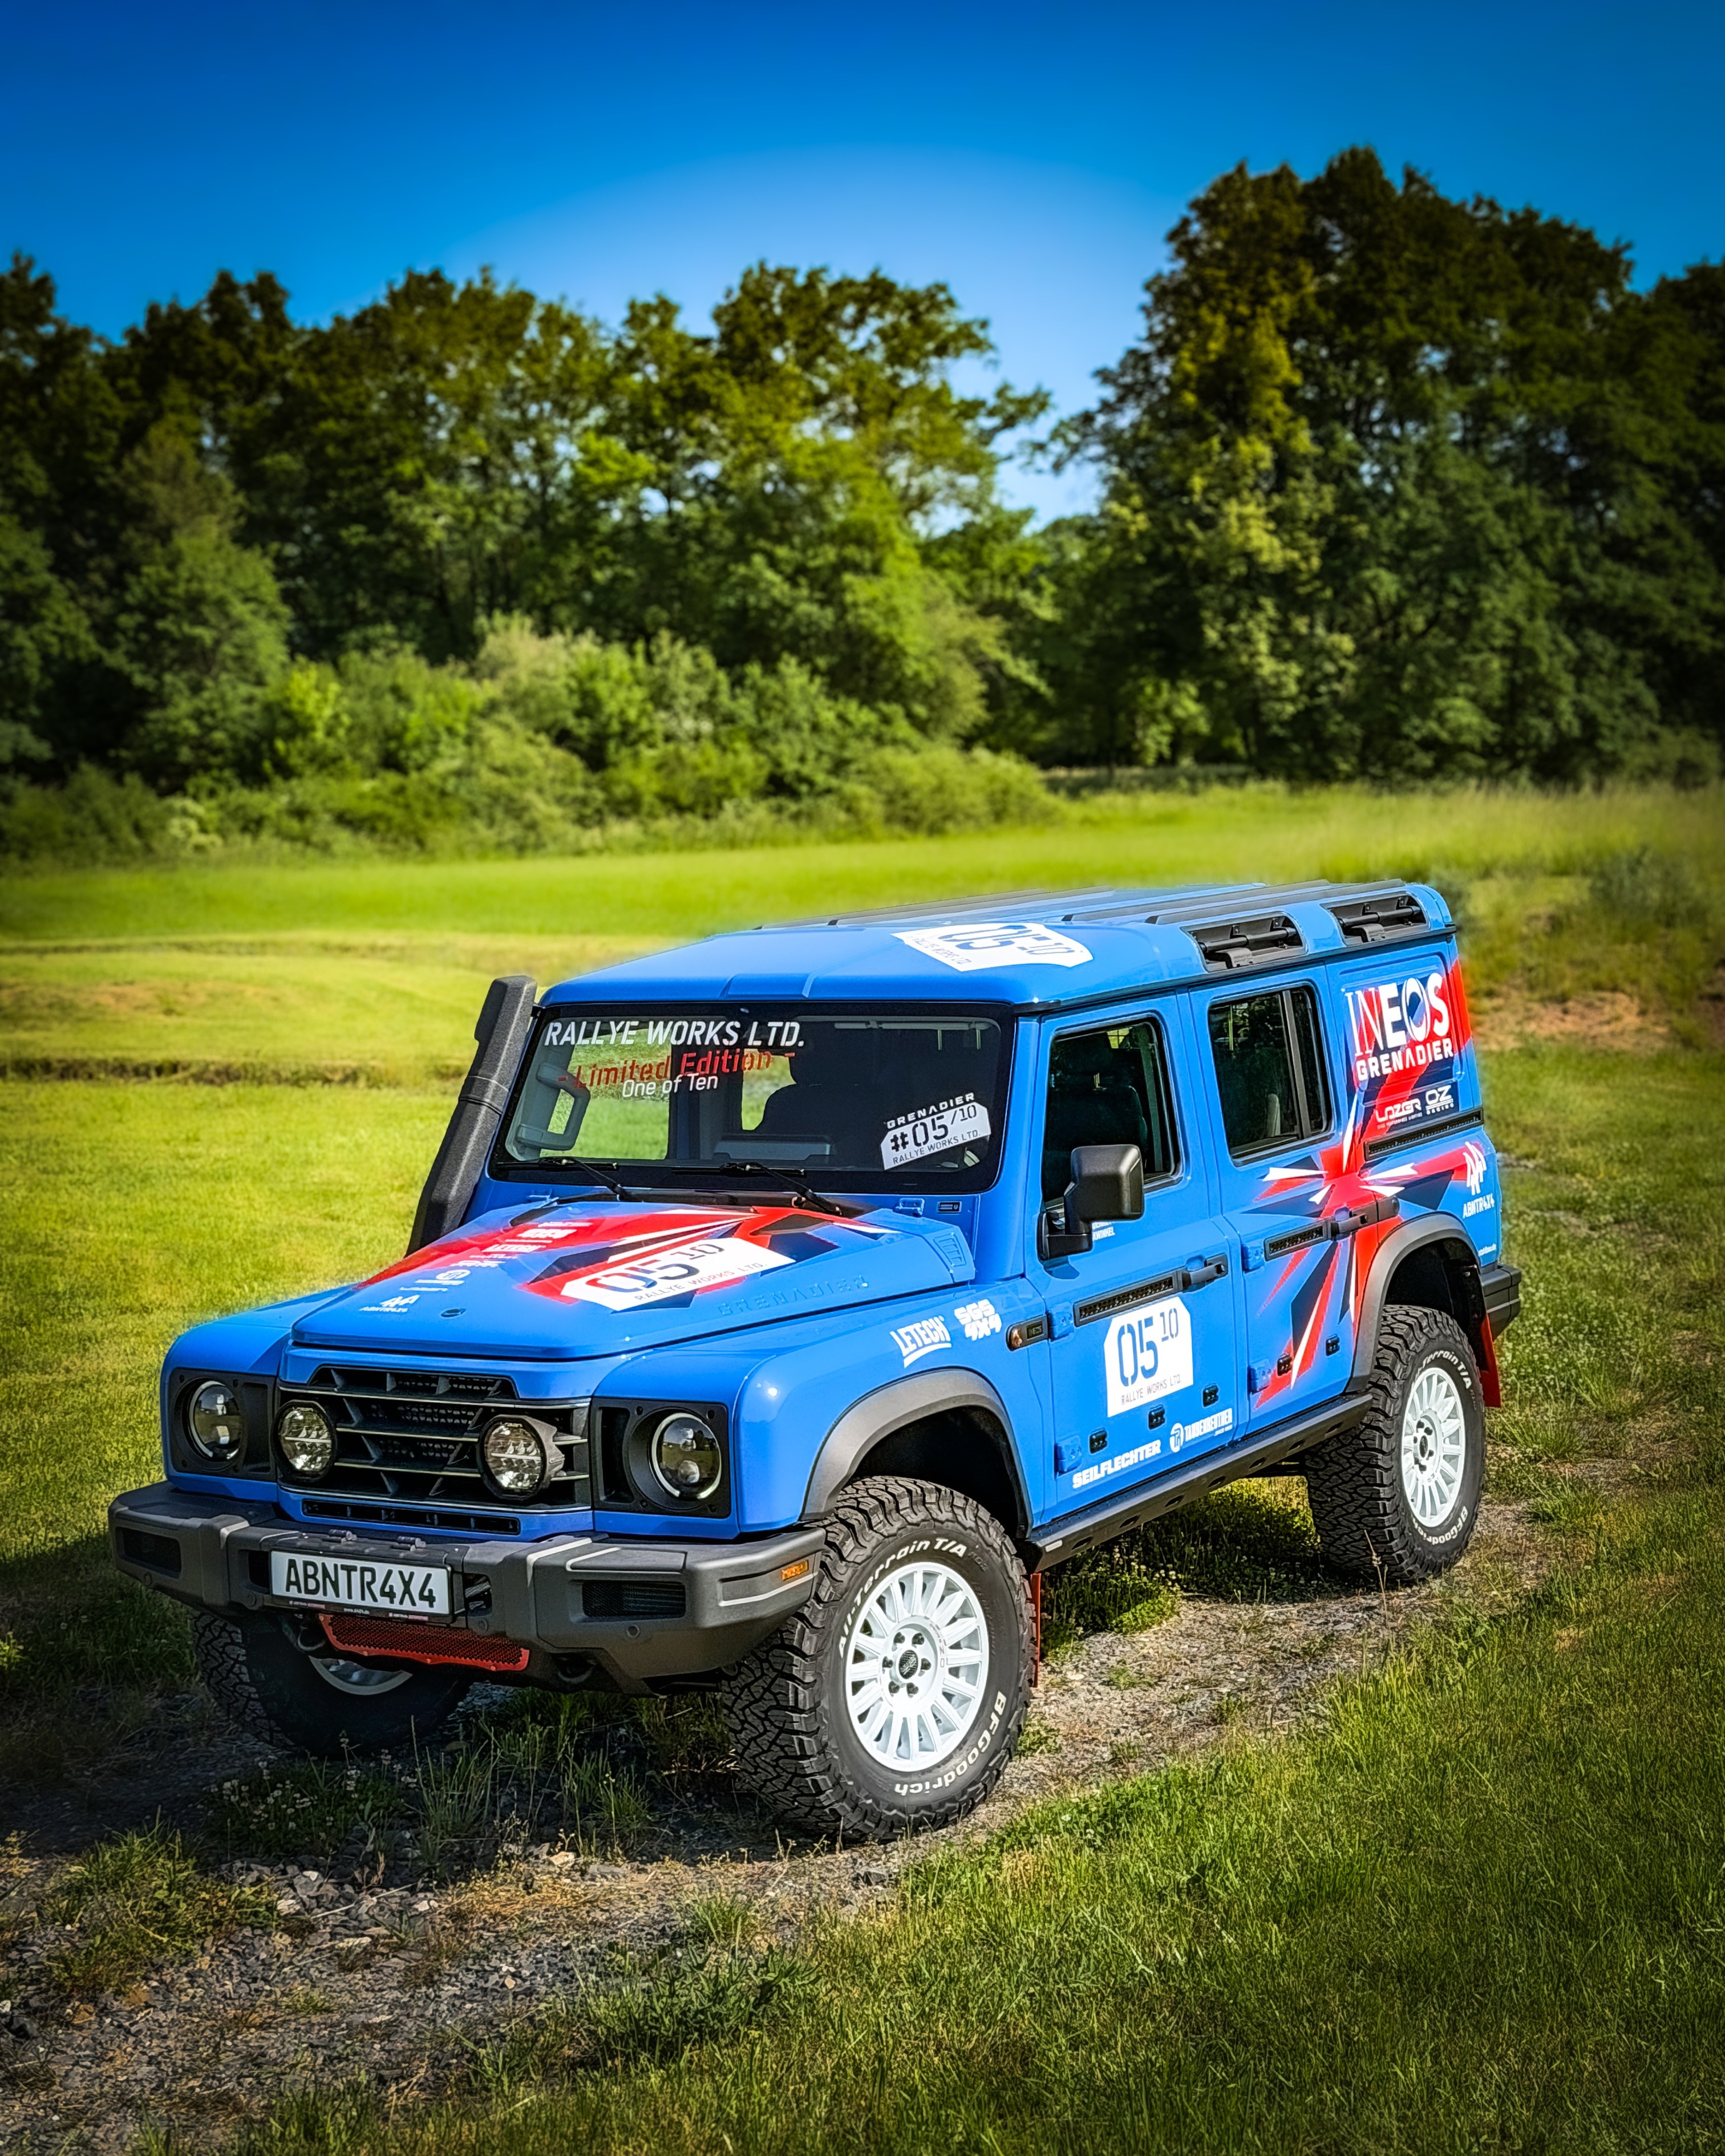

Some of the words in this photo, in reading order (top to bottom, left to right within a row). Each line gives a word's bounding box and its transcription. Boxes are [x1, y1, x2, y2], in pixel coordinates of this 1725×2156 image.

[1345, 972, 1449, 1057] INEOS
[544, 1021, 636, 1046] RALLYE
[647, 1021, 740, 1046] WORKS
[747, 1021, 804, 1047] LTD.
[574, 1055, 671, 1088] Limited
[680, 1048, 772, 1076] Edition
[1356, 1037, 1453, 1081] GRENADIER
[622, 1079, 657, 1098] One
[662, 1076, 683, 1094] of
[687, 1072, 718, 1091] Ten
[1425, 1084, 1452, 1105] OZ
[886, 1092, 975, 1129] GRENADIER
[1375, 1098, 1422, 1122] LAZER
[893, 1147, 925, 1165] RALLYE
[928, 1136, 959, 1152] WORKS
[962, 1129, 981, 1141] LTD.
[1462, 1192, 1495, 1219] ABNTR4X4
[585, 1259, 700, 1292] 05
[670, 1243, 724, 1260] 10
[634, 1284, 685, 1300] RALLYE
[687, 1270, 735, 1285] WORKS
[738, 1262, 767, 1272] LTD.
[954, 1298, 995, 1326] SGS
[890, 1316, 951, 1357] LETECH
[1117, 1316, 1159, 1387] 05
[1160, 1308, 1179, 1343] 10
[1121, 1388, 1144, 1405] RALLYE
[1147, 1379, 1167, 1395] WORKS
[1169, 1373, 1182, 1387] LTD.
[1457, 1361, 1472, 1389] T/A
[1072, 1440, 1161, 1489] SEILFLECHTER
[285, 1558, 436, 1610] ABNTR4X4
[839, 1540, 930, 1659] All-Terrain
[934, 1537, 967, 1558] T/A
[894, 1691, 1007, 1796] BFGoodrich
